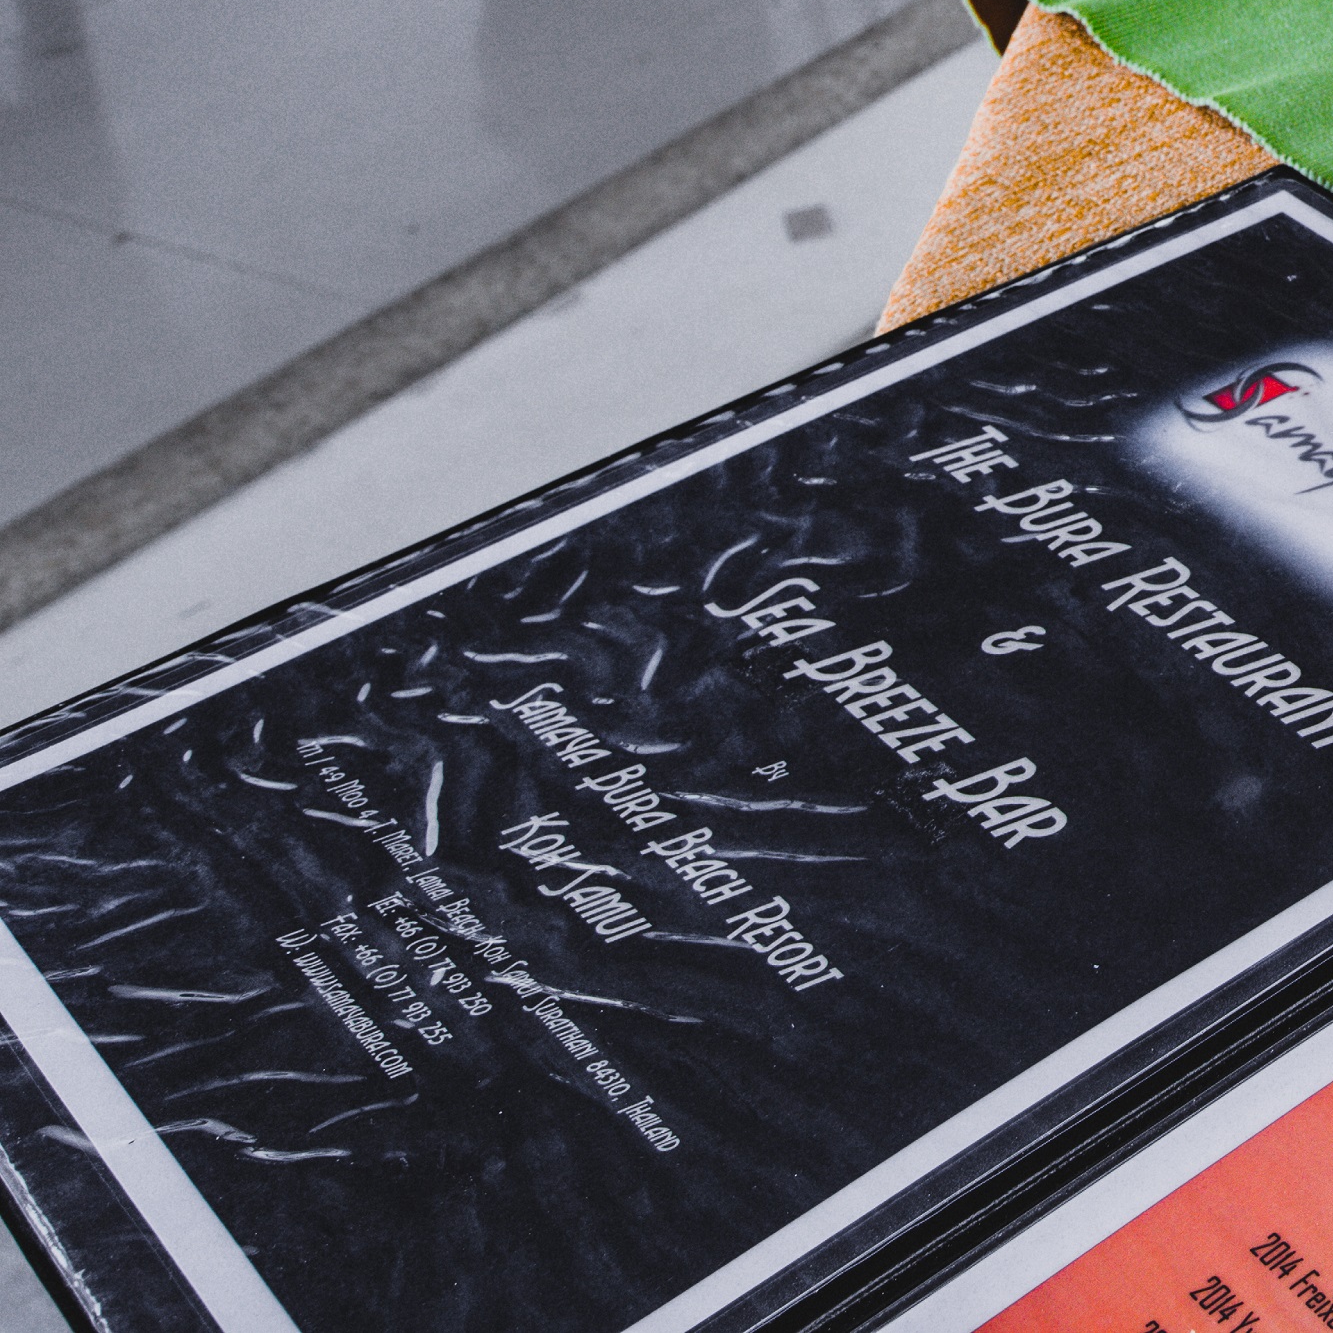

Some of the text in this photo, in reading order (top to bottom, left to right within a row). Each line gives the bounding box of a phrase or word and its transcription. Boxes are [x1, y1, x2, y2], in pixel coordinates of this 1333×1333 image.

[908, 425, 1019, 484] THE
[974, 479, 1132, 567] BURA
[981, 625, 1047, 656] &
[704, 577, 1069, 849] SEA BREEZE BAR
[364, 817, 398, 835] T.
[373, 829, 424, 872] MARET,
[490, 682, 845, 992] SAMAYA BURA BEACH RESORT
[498, 812, 653, 944] KOH SAMUI
[355, 945, 384, 966] +66
[388, 986, 416, 1002] 77
[402, 1002, 432, 1023] 913
[418, 1021, 453, 1045] 255
[395, 917, 423, 938] +66
[428, 957, 457, 973] 77
[443, 973, 472, 994] 913
[458, 992, 493, 1016] 250
[586, 1059, 631, 1102] 84310,
[617, 1095, 681, 1152] THAILAND
[1249, 1232, 1304, 1280] 2014
[1188, 1275, 1245, 1326] 2014
